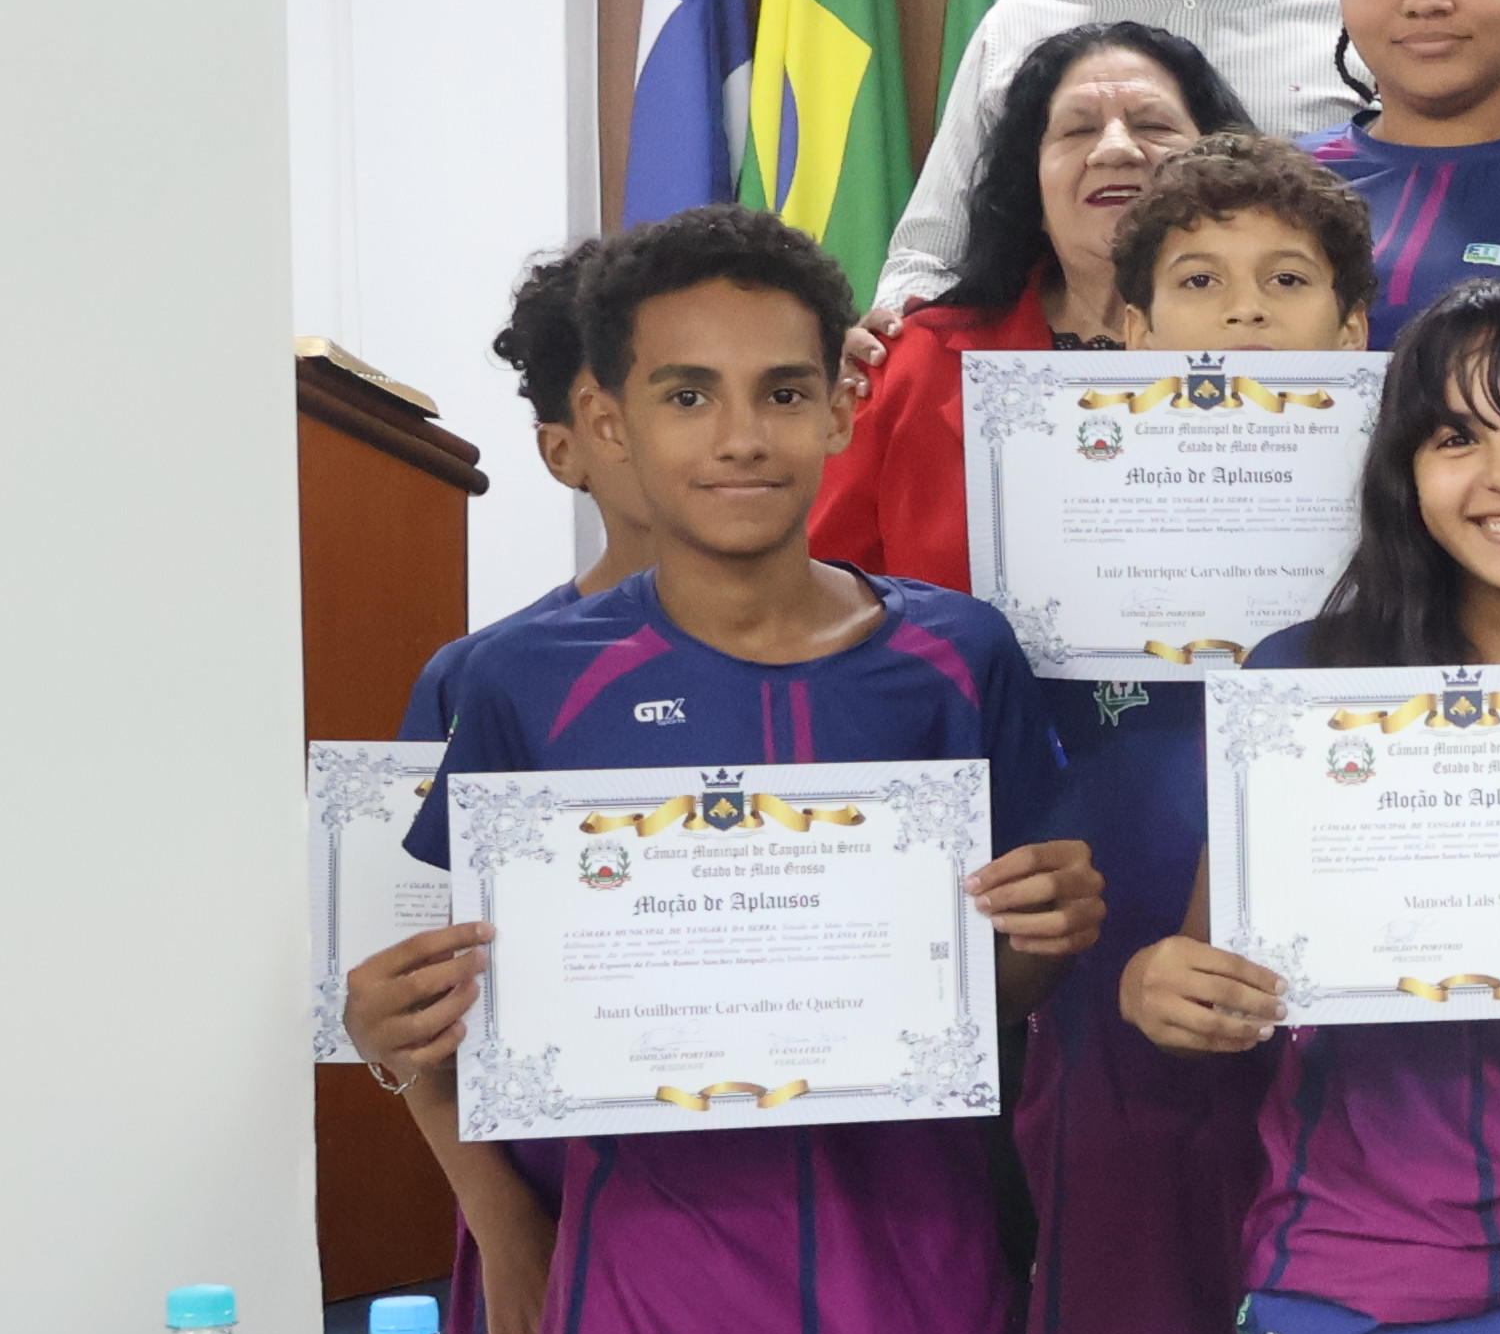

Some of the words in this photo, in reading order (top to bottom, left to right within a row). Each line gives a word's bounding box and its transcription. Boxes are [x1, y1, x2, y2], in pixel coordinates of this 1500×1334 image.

[1124, 465, 1183, 488] Moção
[1187, 466, 1207, 485] de
[1211, 466, 1294, 487] Aplausos
[634, 698, 687, 723] GTX
[1376, 788, 1438, 813] Moção
[1442, 789, 1463, 808] de
[632, 892, 698, 918] Moção
[702, 893, 725, 913] de
[729, 891, 821, 914] Aplausos
